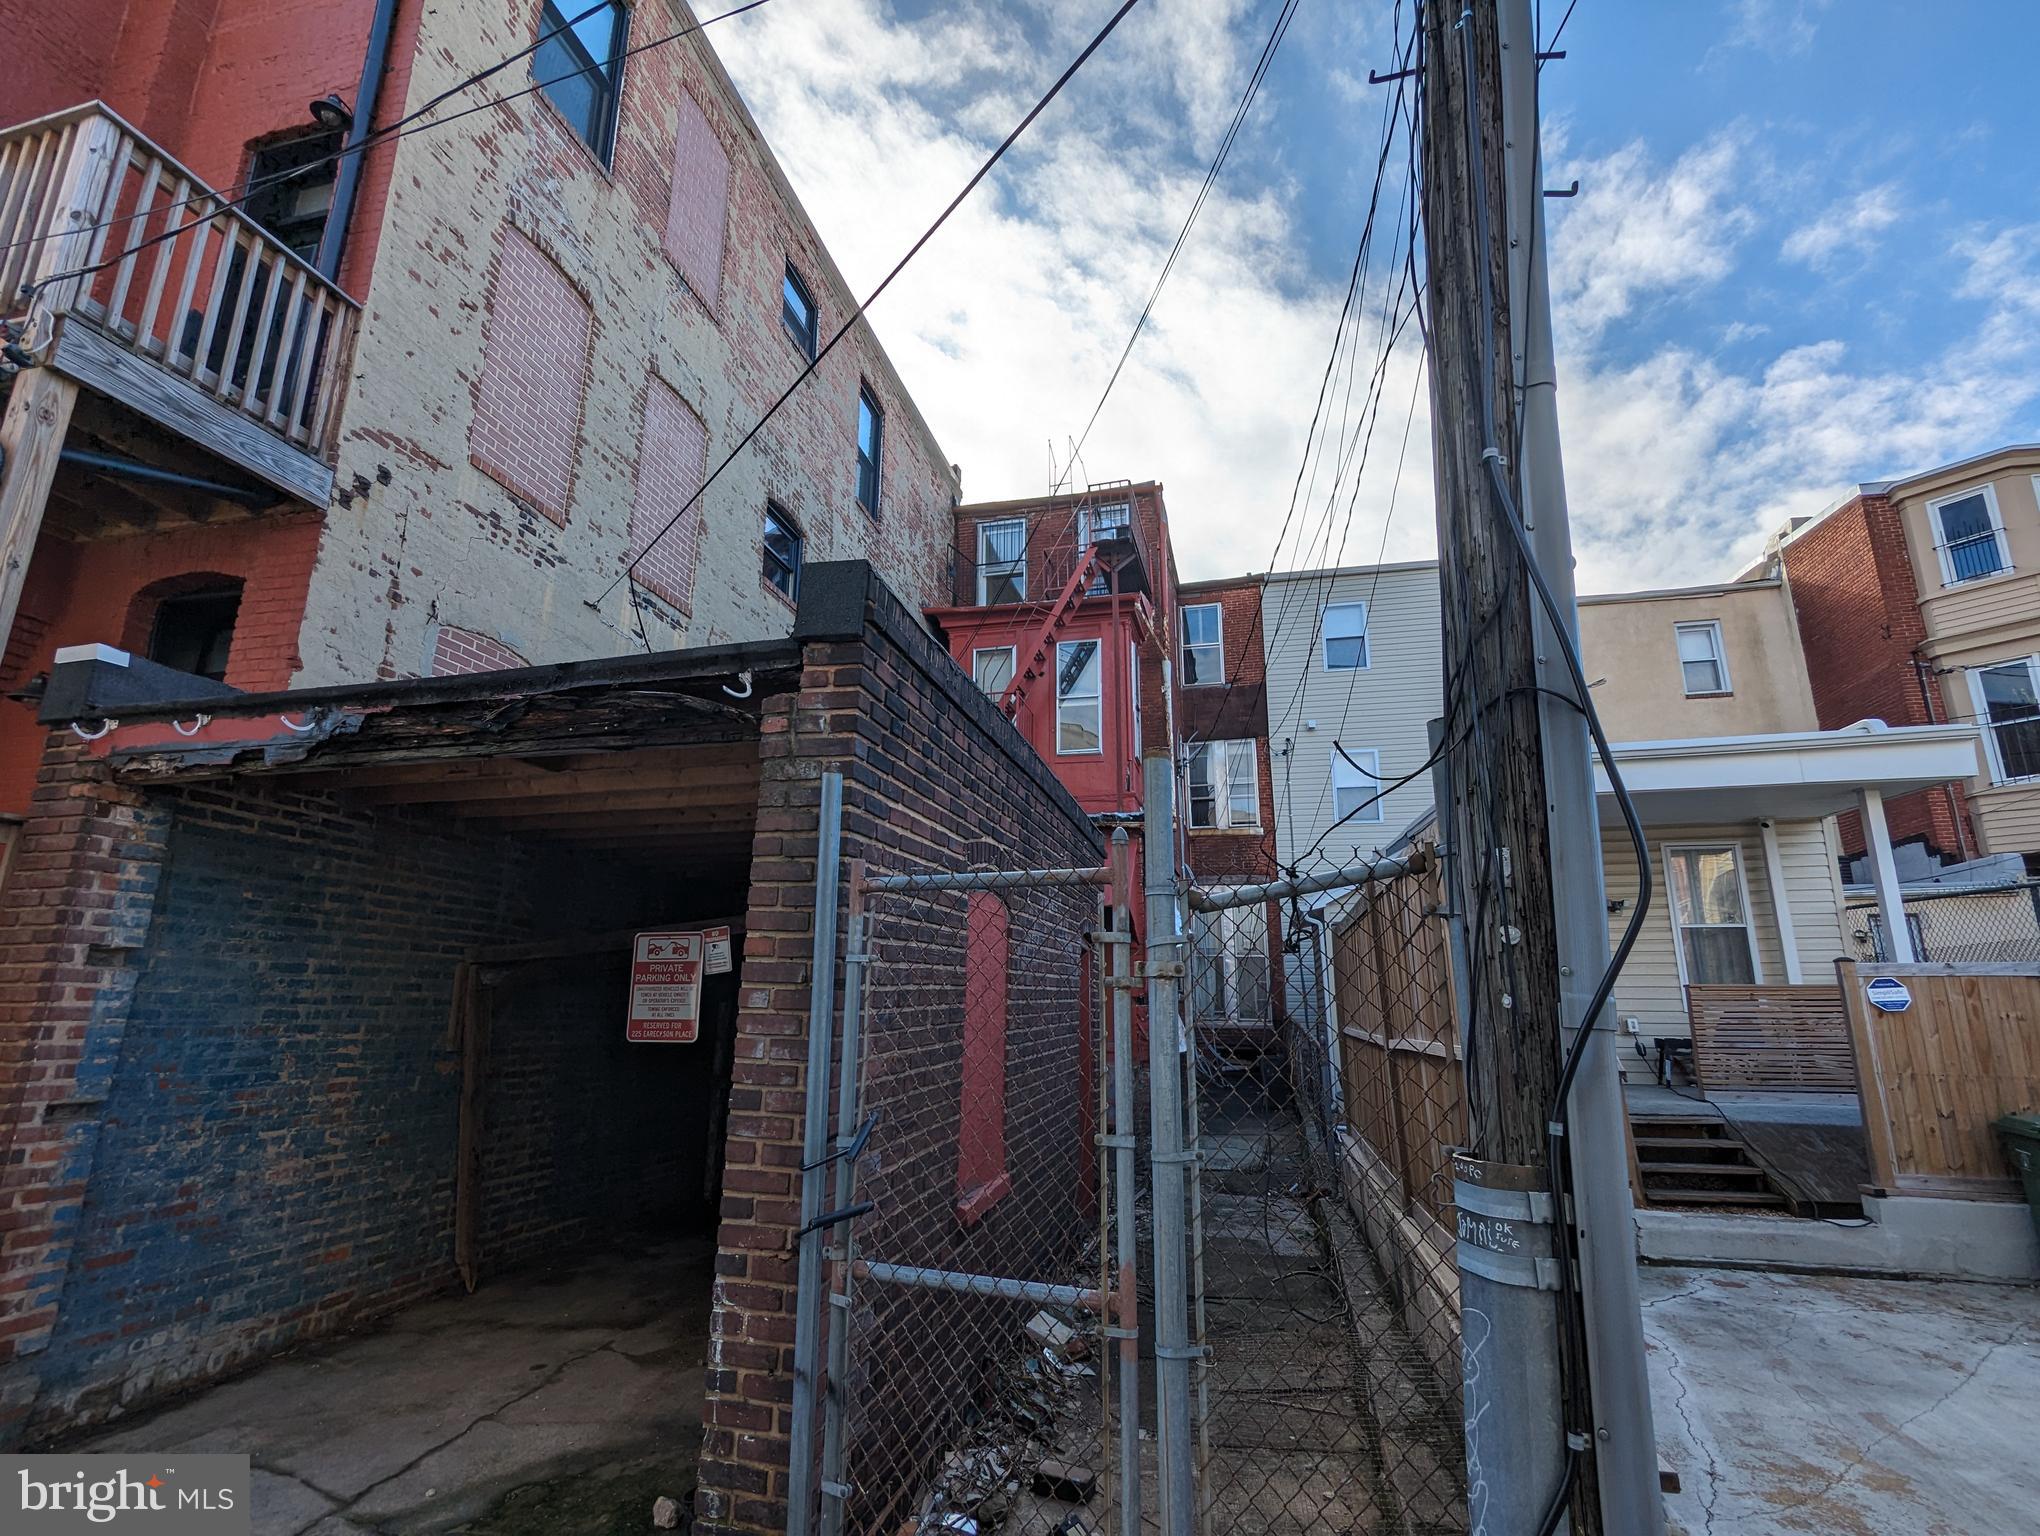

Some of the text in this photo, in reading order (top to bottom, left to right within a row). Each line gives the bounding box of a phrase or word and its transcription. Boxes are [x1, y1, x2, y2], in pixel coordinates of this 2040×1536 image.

[650, 964, 684, 972] PRIVATE
[635, 973, 697, 982] PARKING ONLY
[675, 1030, 692, 1038] PLACE
